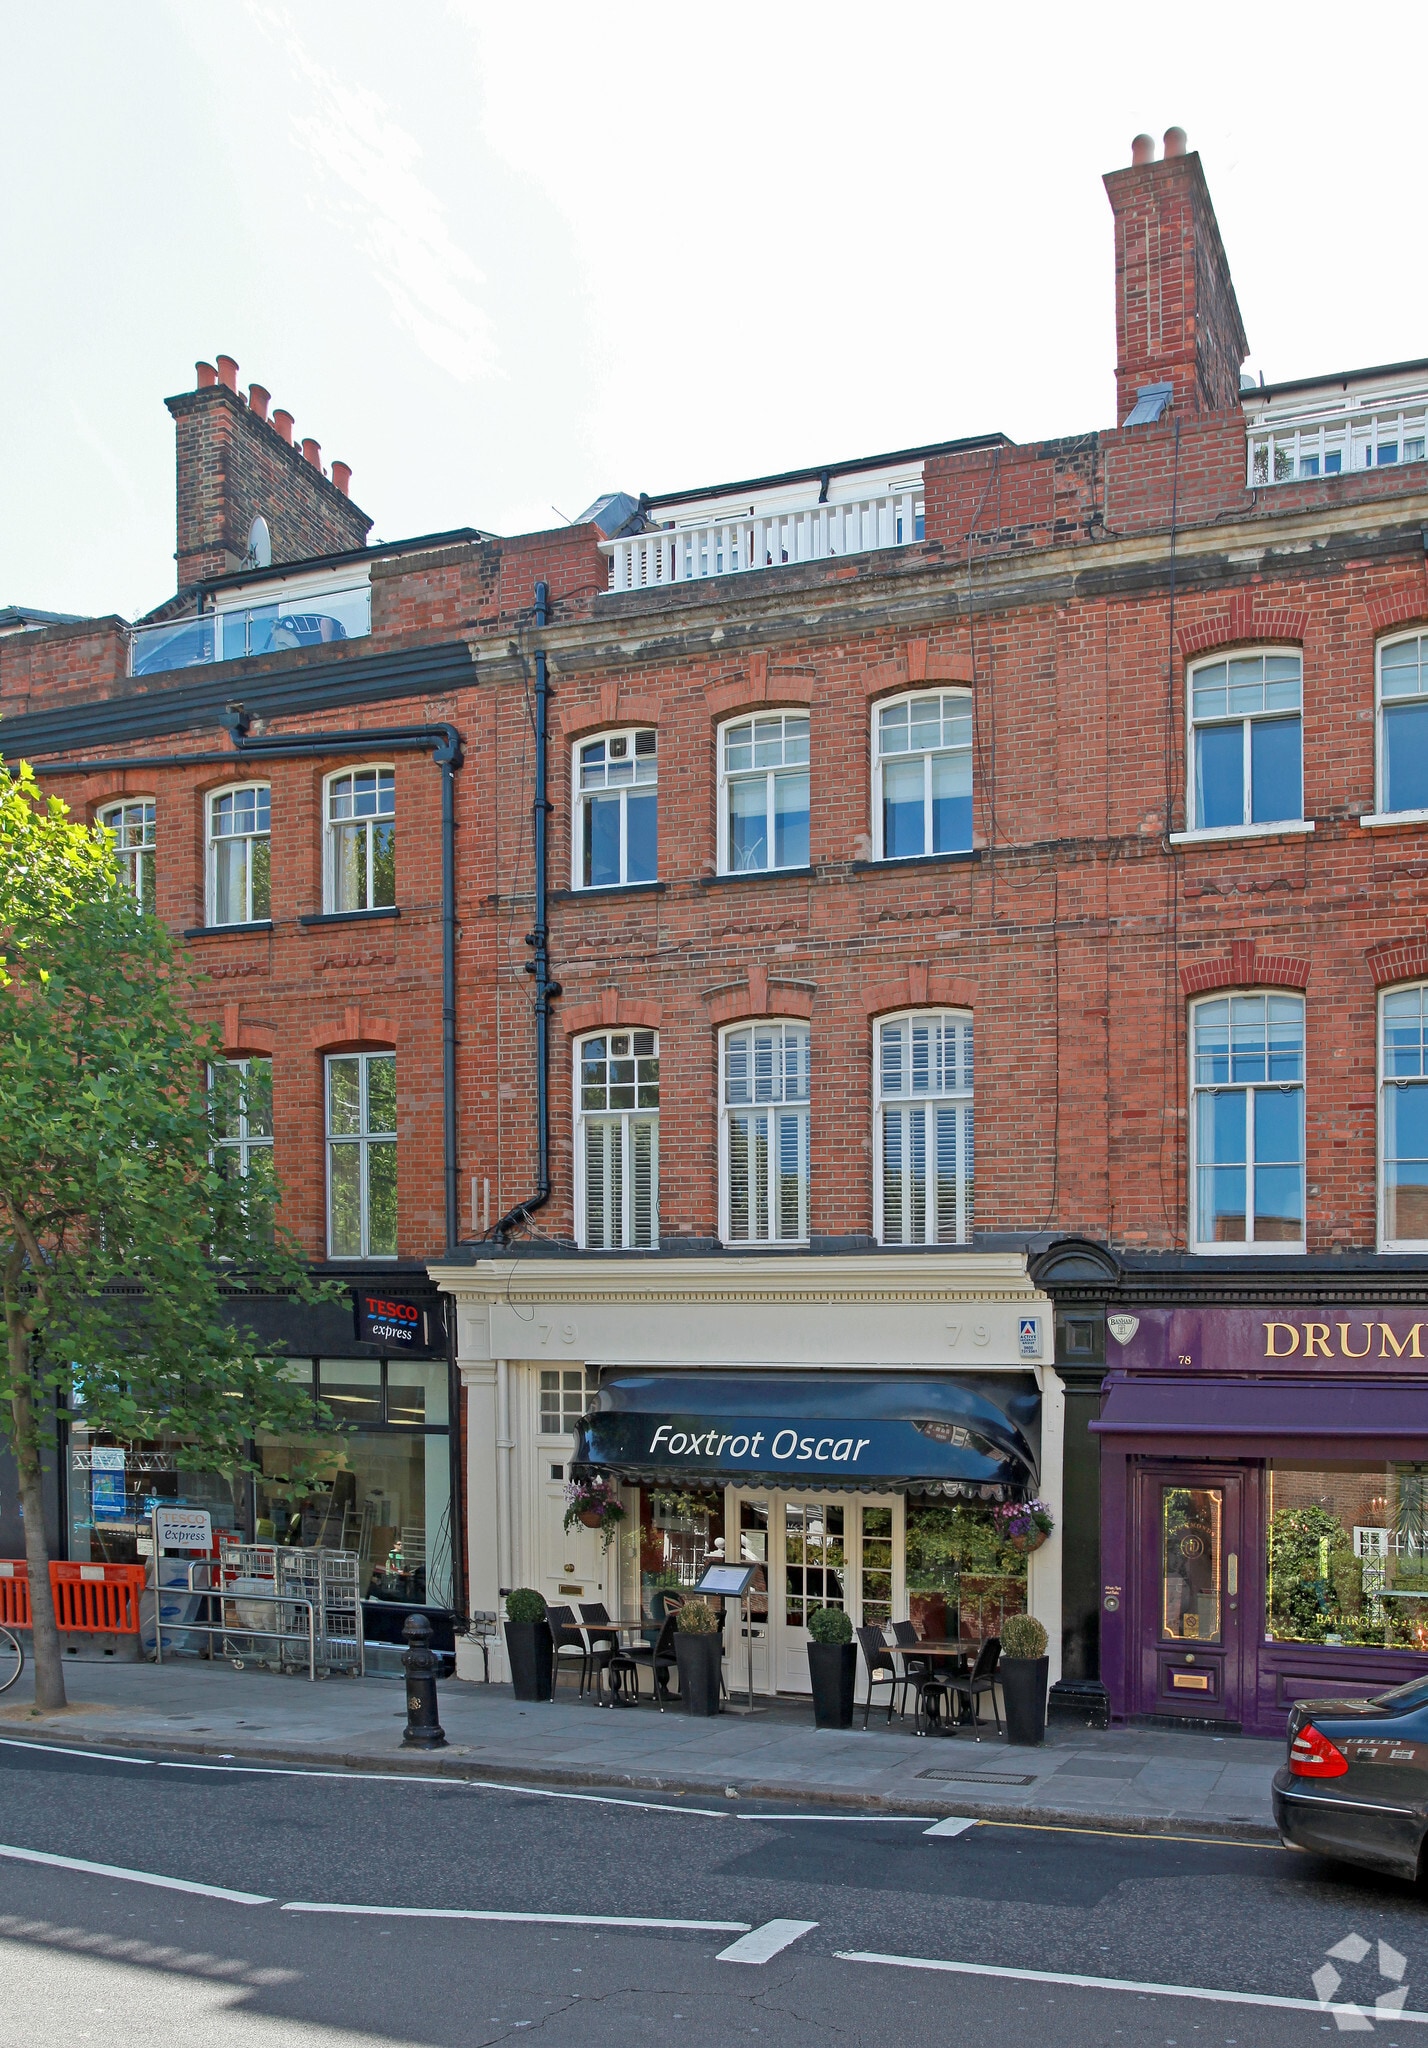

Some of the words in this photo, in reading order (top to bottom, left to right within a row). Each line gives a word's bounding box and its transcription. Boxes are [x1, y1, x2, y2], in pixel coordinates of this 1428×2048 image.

[365, 1297, 418, 1321] TESCO
[372, 1324, 412, 1340] express
[538, 1322, 578, 1345] 79
[945, 1322, 991, 1347] 79
[1262, 1322, 1428, 1358] DRUM
[1178, 1355, 1192, 1365] 78
[649, 1425, 765, 1458] Foxtrot
[771, 1429, 870, 1461] Oscar
[162, 1512, 205, 1525] TESCO
[164, 1529, 206, 1543] express
